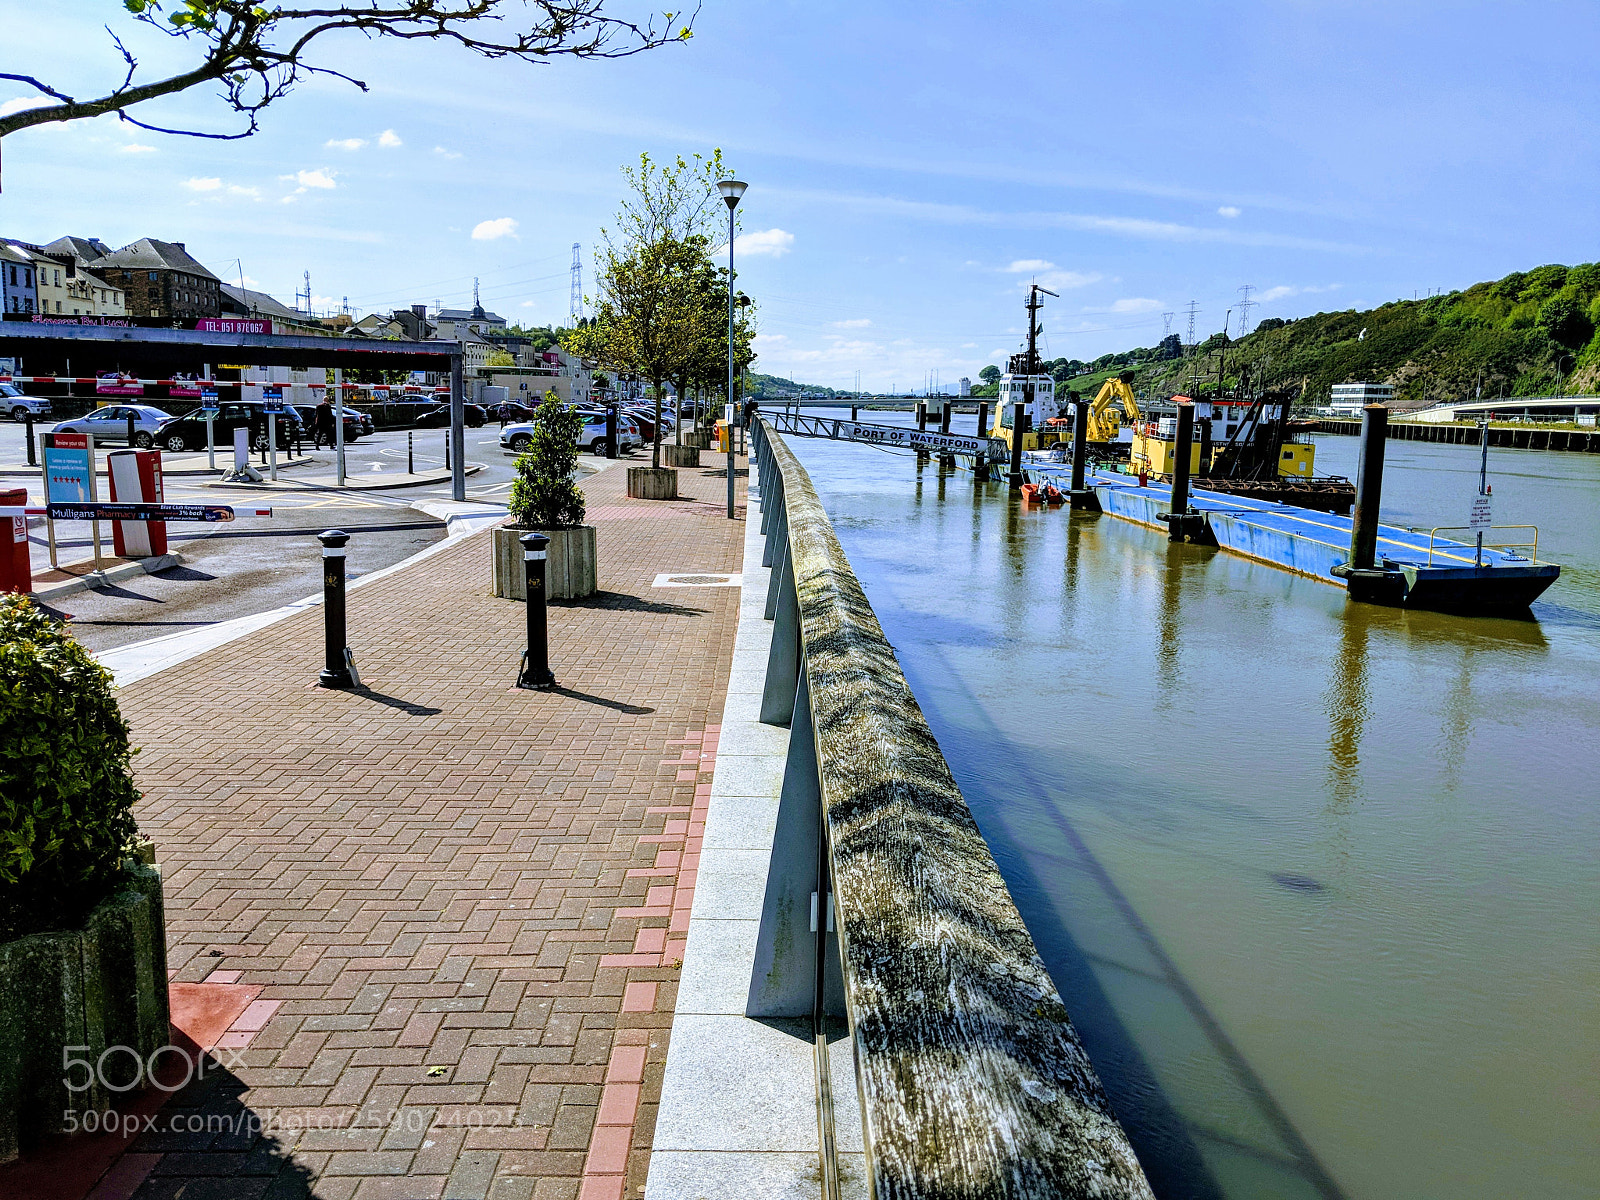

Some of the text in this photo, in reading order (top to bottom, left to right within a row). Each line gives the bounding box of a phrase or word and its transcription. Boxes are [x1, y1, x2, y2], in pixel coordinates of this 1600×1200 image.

[205, 321, 220, 332] TEL:
[221, 322, 234, 332] 051
[853, 427, 979, 449] PORT OF WATERFORD
[52, 508, 136, 519] Mulligans Pharmacy
